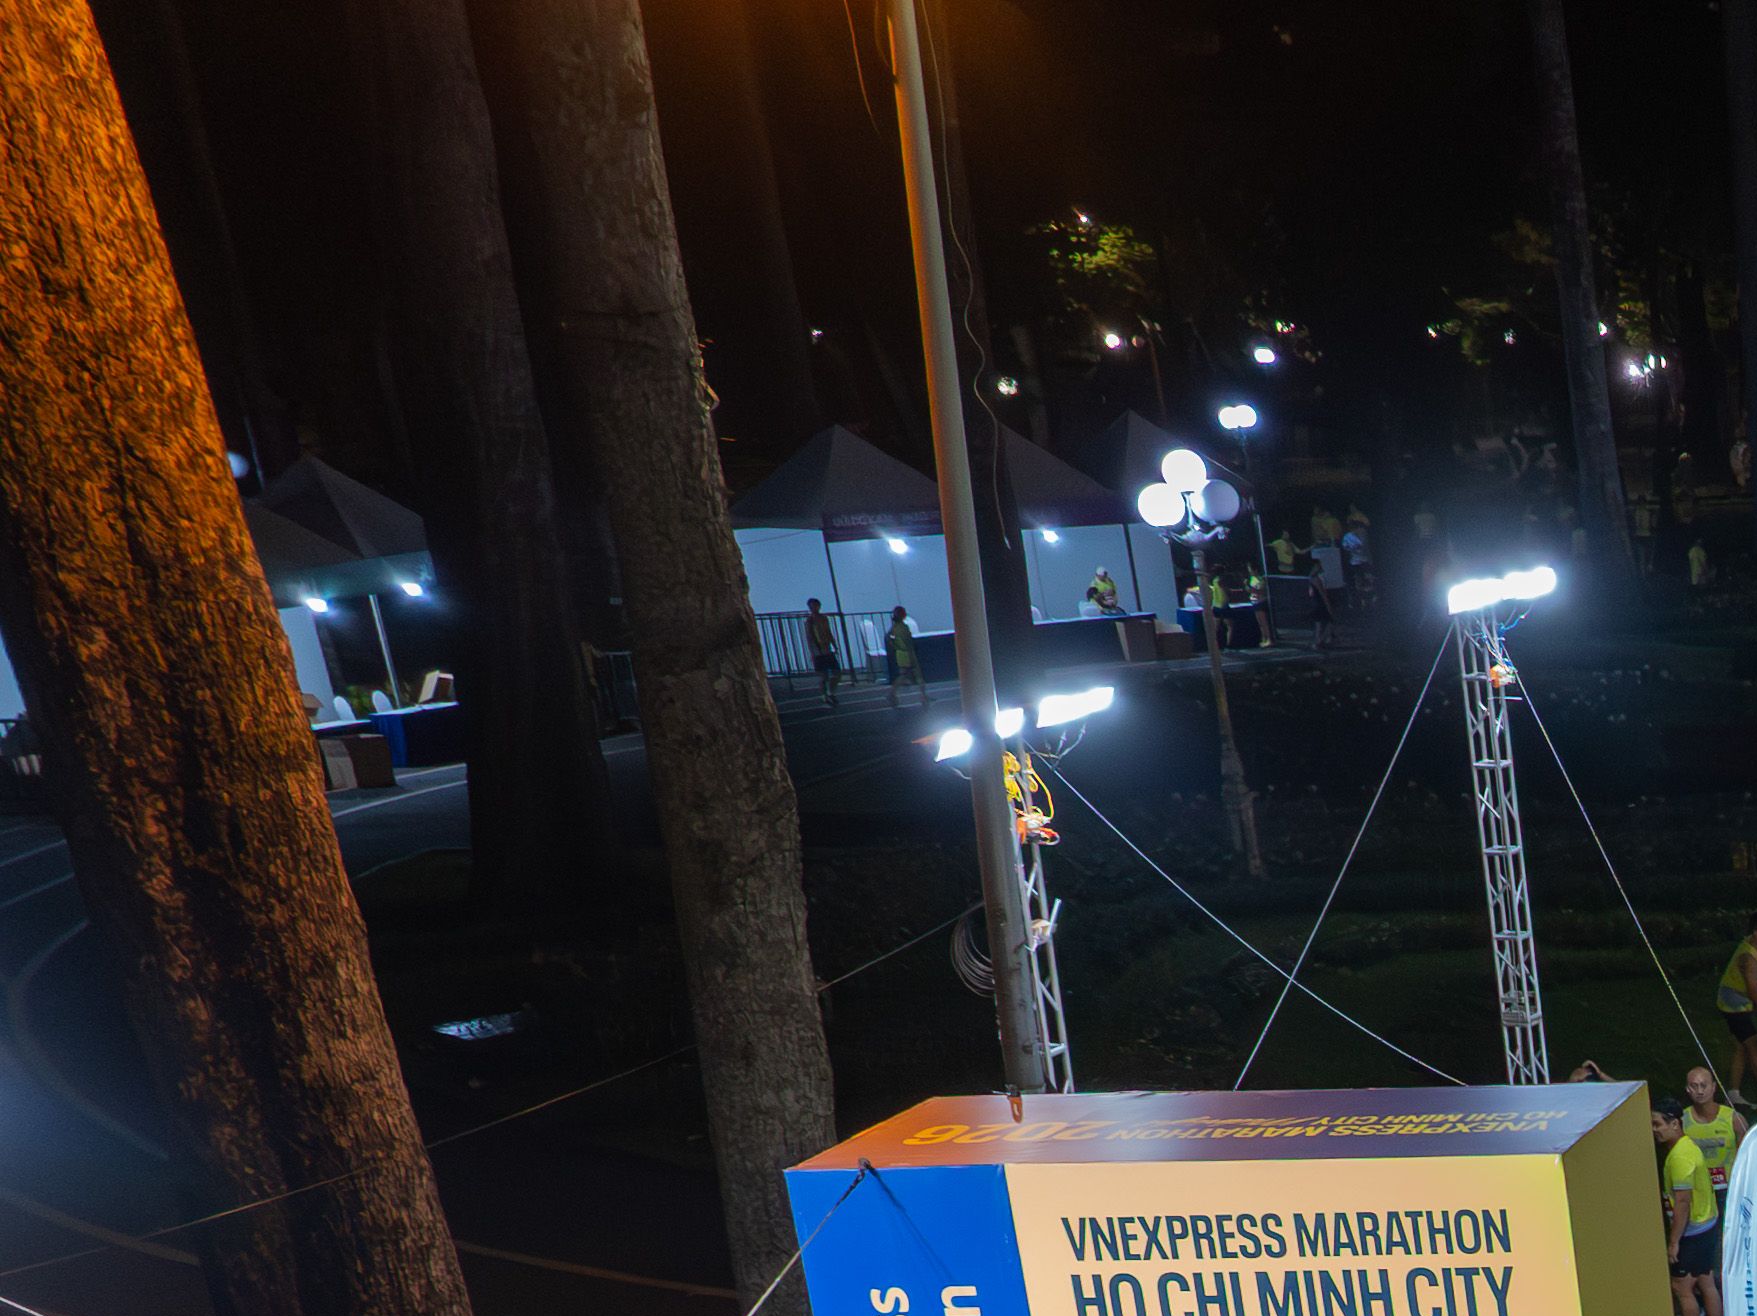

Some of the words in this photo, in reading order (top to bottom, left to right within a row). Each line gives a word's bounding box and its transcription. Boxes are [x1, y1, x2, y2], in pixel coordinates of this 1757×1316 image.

[902, 1121, 1111, 1146] 2026
[1061, 1212, 1287, 1263] VNEXPRESS
[1296, 1208, 1512, 1259] MARATHON
